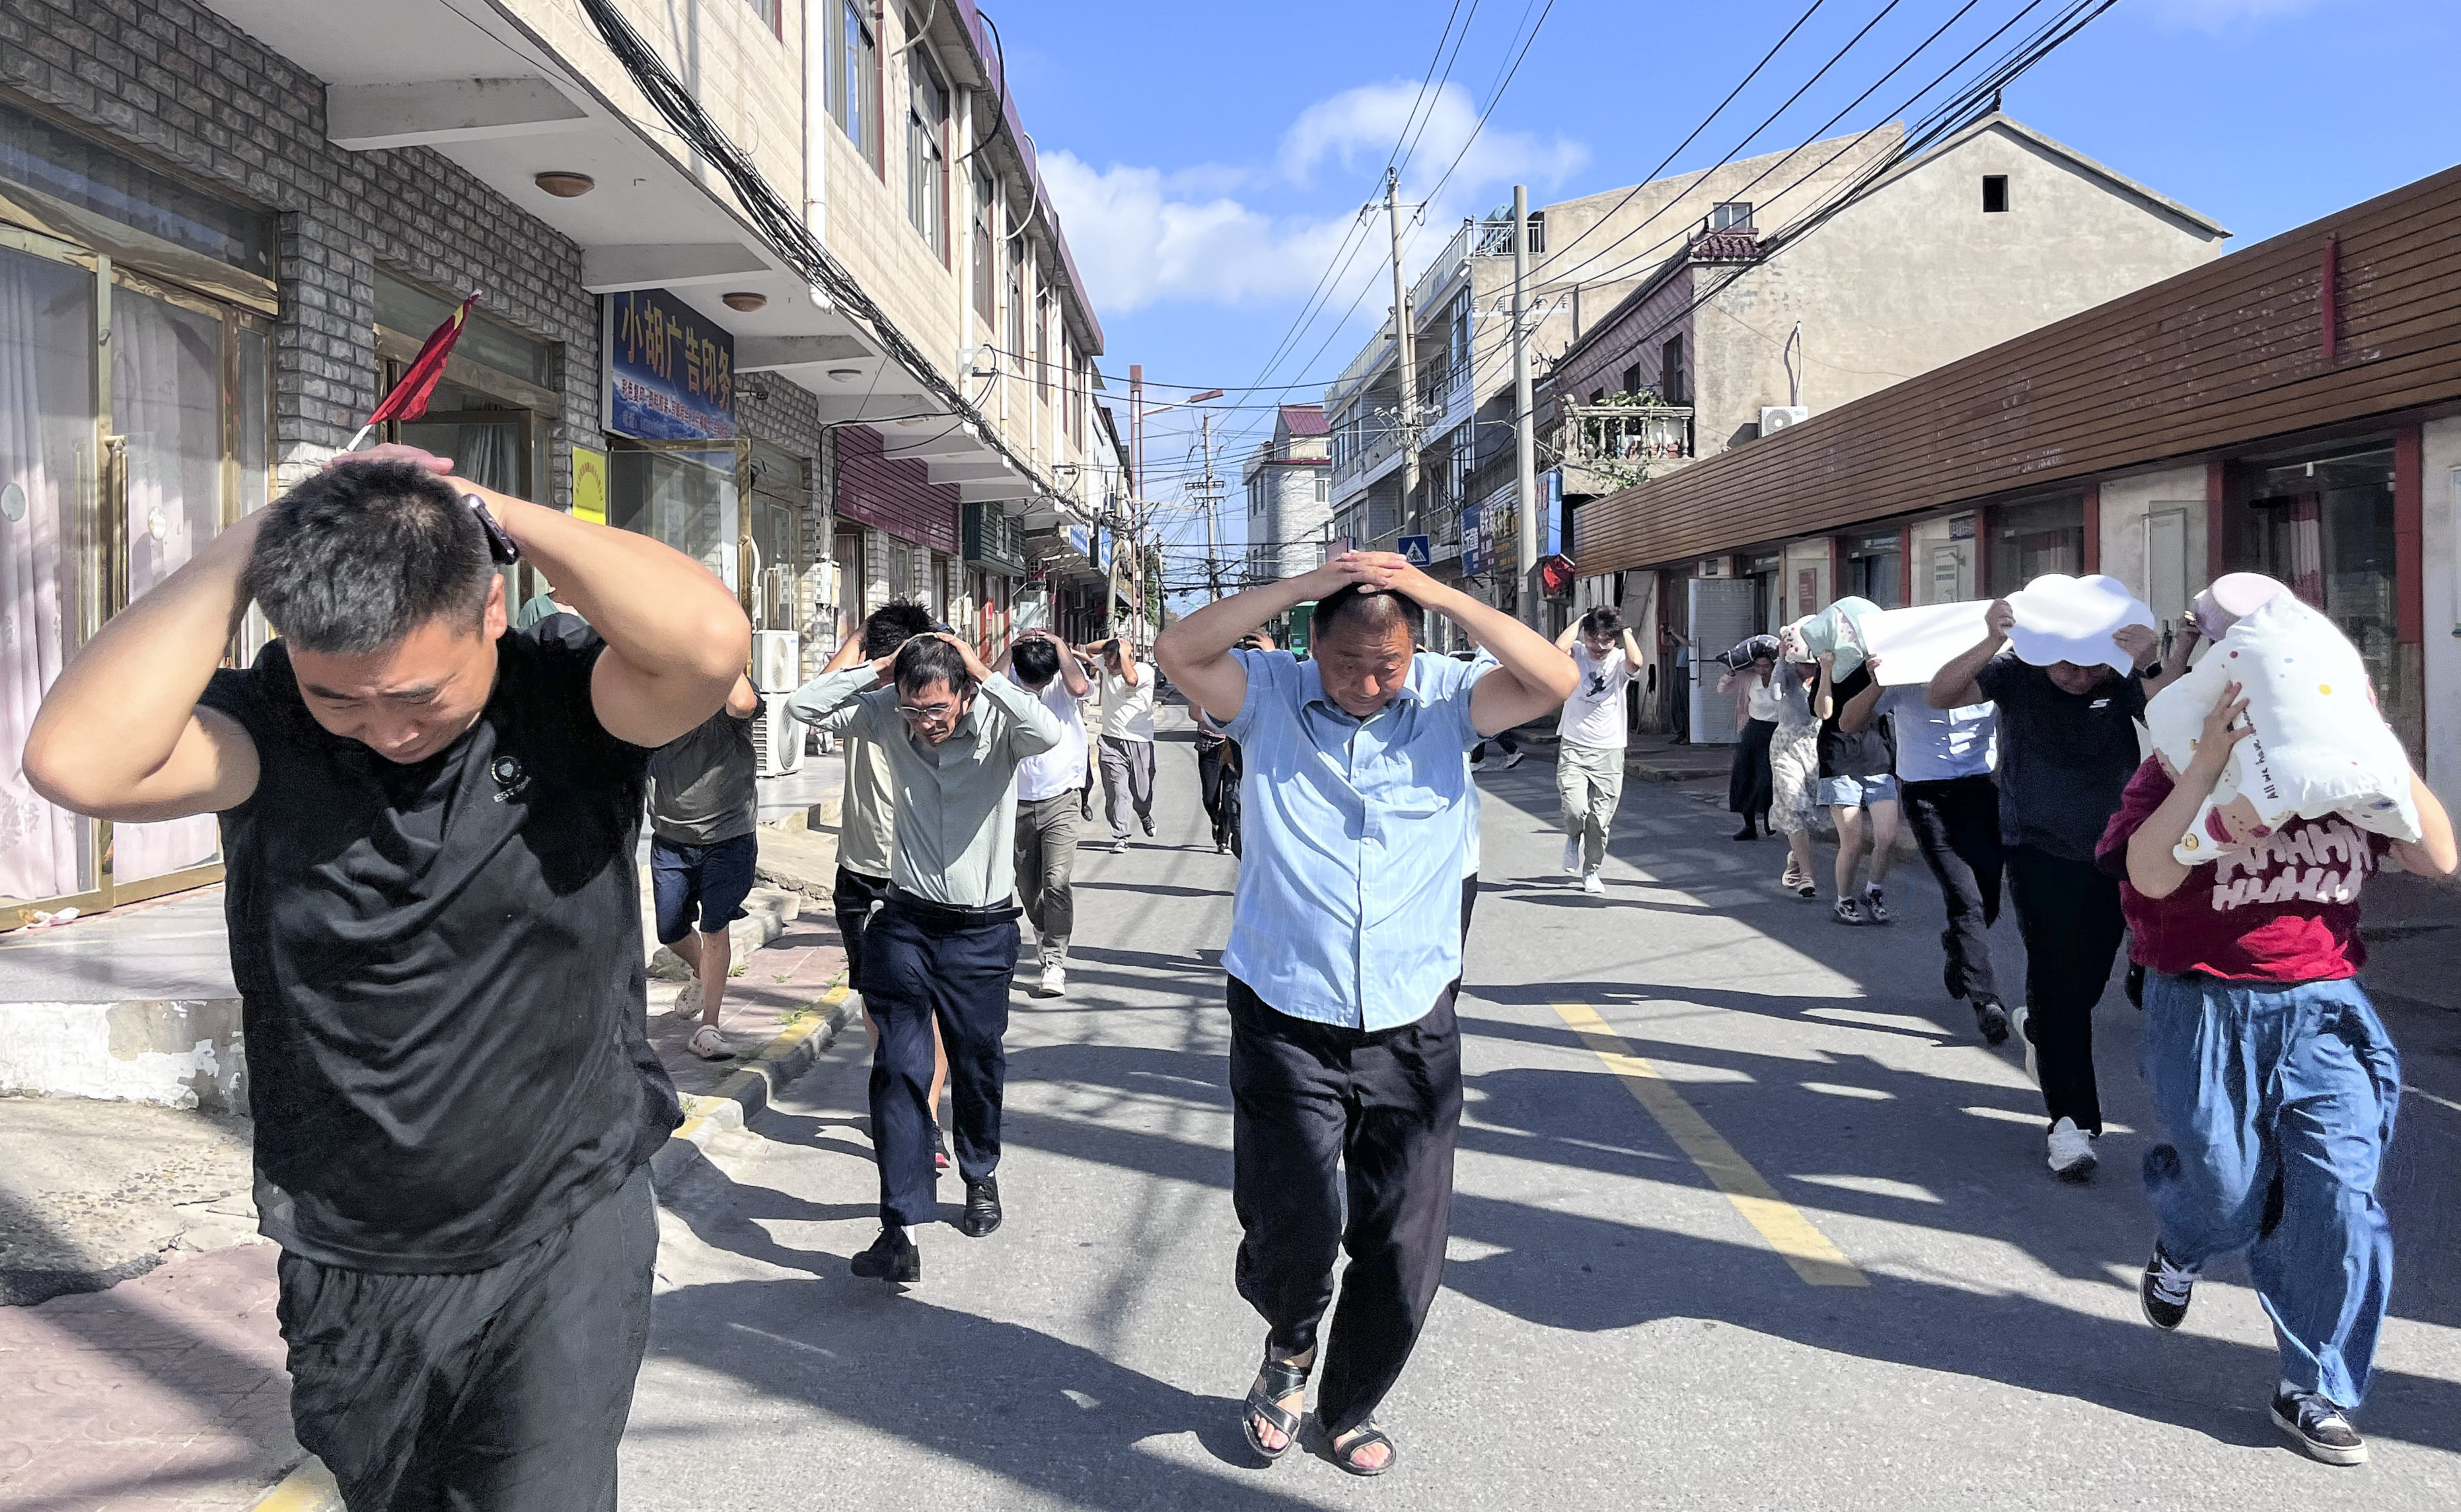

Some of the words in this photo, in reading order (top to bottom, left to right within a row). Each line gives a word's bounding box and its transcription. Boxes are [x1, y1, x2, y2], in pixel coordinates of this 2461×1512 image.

[621, 291, 731, 412] 小胡广告印务
[2261, 767, 2271, 783] we
[2264, 784, 2279, 799] All
